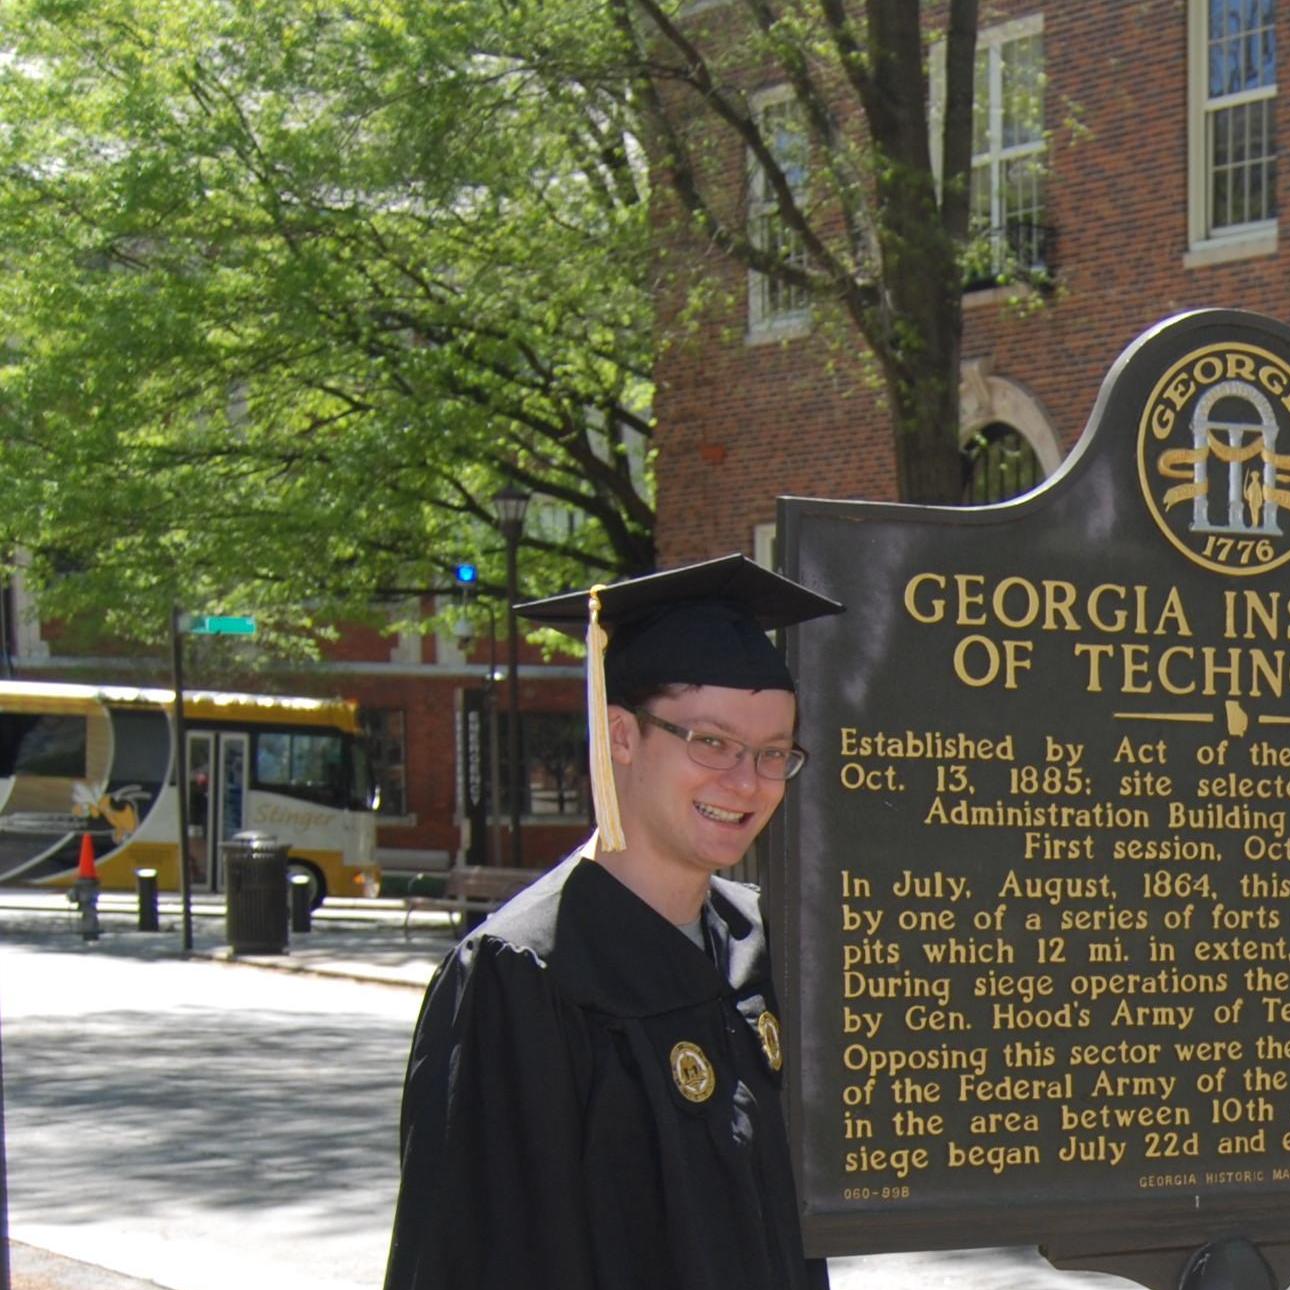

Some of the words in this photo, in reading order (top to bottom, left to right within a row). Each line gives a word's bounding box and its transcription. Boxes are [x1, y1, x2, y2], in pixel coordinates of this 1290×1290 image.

[1202, 535, 1275, 564] 1776
[904, 572, 1193, 637] GEORGIA
[953, 634, 1034, 689] OF
[840, 727, 1015, 761] Established
[1045, 735, 1085, 768] by
[1113, 735, 1167, 765] Act
[1196, 739, 1229, 766] of
[840, 762, 905, 791] Oct.
[936, 764, 976, 795] 13,
[1119, 769, 1173, 797] site
[923, 796, 1150, 828] Administration
[1167, 801, 1286, 838] Building
[1024, 831, 1095, 860] First
[1113, 835, 1222, 862] session,
[841, 870, 871, 898] In
[892, 869, 972, 902] July,
[998, 869, 1117, 906] August,
[1143, 869, 1218, 900] 1864,
[841, 903, 884, 936] by
[898, 909, 956, 931] one
[973, 903, 1007, 931] of
[1025, 913, 1042, 931] a
[1060, 904, 1148, 931] series
[1163, 903, 1195, 930] of
[1211, 903, 1281, 930] forts
[843, 937, 900, 971] pits
[922, 937, 1014, 964] which
[1037, 936, 1066, 964] 12
[1088, 936, 1129, 962] mi.
[1149, 935, 1175, 962] in
[843, 969, 951, 1007] During
[973, 969, 1054, 1004] siege
[1070, 967, 1228, 1001] operations
[1243, 966, 1289, 992] the
[843, 1006, 883, 1039] by
[904, 1005, 972, 1031] Gen.
[992, 1000, 1091, 1030] Hood's
[1110, 998, 1195, 1030] Army
[1213, 997, 1244, 1024] of
[843, 1043, 988, 1077] Opposing
[1002, 1040, 1056, 1068] this
[1069, 1040, 1162, 1066] sector
[1173, 1040, 1243, 1062] were
[842, 1077, 876, 1106] of
[890, 1077, 941, 1104] the
[958, 1073, 1073, 1102] Federal
[1091, 1069, 1177, 1101] Army
[1196, 1066, 1227, 1093] of
[1243, 1066, 1288, 1092] the
[844, 1110, 873, 1139] in
[891, 1109, 944, 1137] the
[970, 1112, 1039, 1134] area
[1061, 1104, 1191, 1131] between
[1211, 1096, 1274, 1124] 10th
[845, 1145, 929, 1179] siege
[947, 1141, 1041, 1175] began
[1058, 1135, 1127, 1166] July
[1144, 1132, 1199, 1158] 22d
[1217, 1128, 1266, 1155] and
[1138, 1173, 1197, 1188] GEORGIA
[1205, 1170, 1264, 1184] HISTORIC
